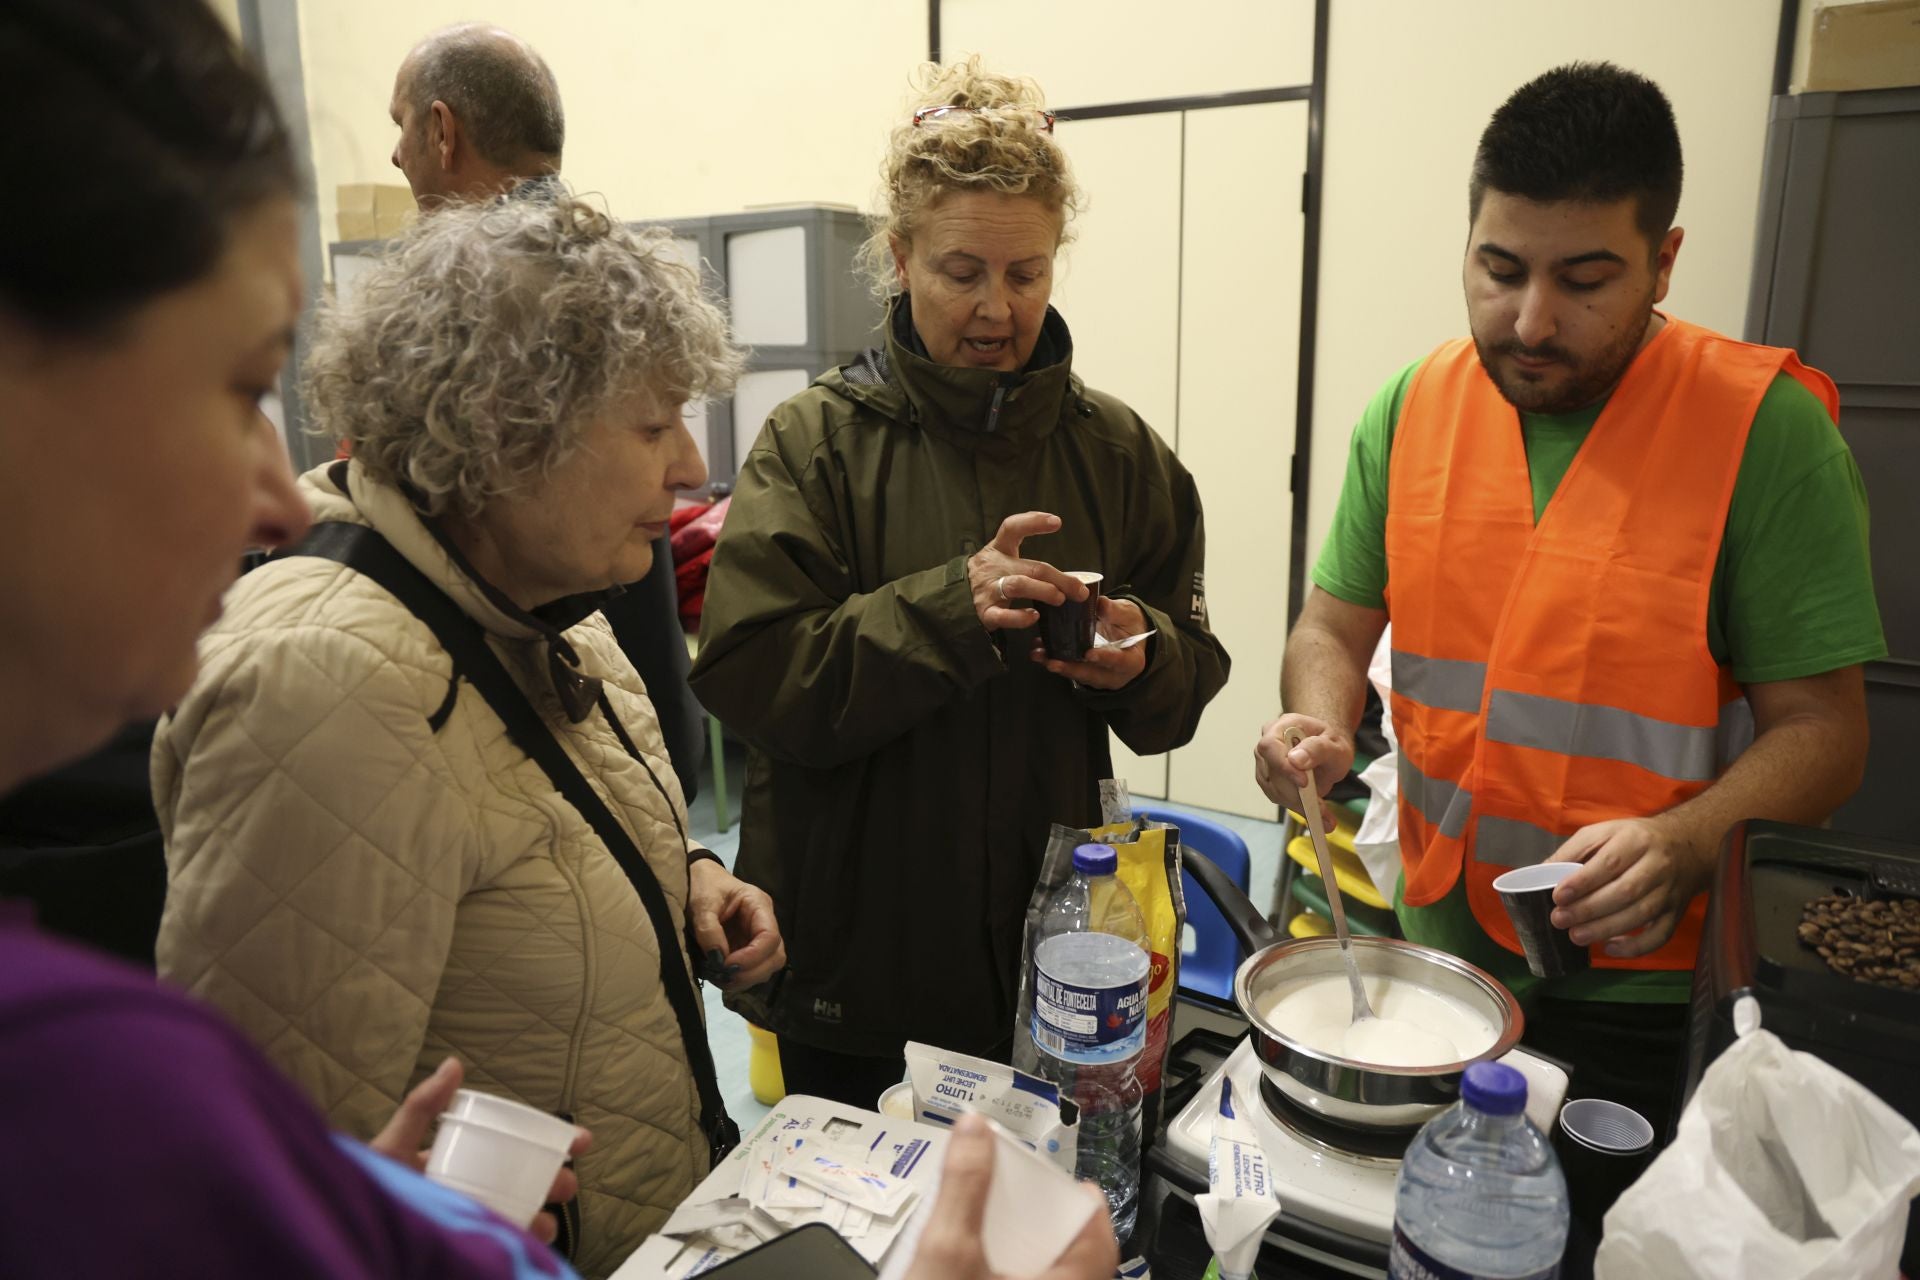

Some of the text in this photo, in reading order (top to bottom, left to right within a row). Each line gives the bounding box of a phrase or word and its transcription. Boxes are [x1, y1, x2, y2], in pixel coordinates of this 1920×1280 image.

[1116, 992, 1139, 1010] AGUA
[938, 1063, 988, 1083] SEMIDESNATADA
[935, 1083, 968, 1101] LITRO
[956, 1077, 977, 1089] LECHE
[1253, 1163, 1265, 1197] LITRO
